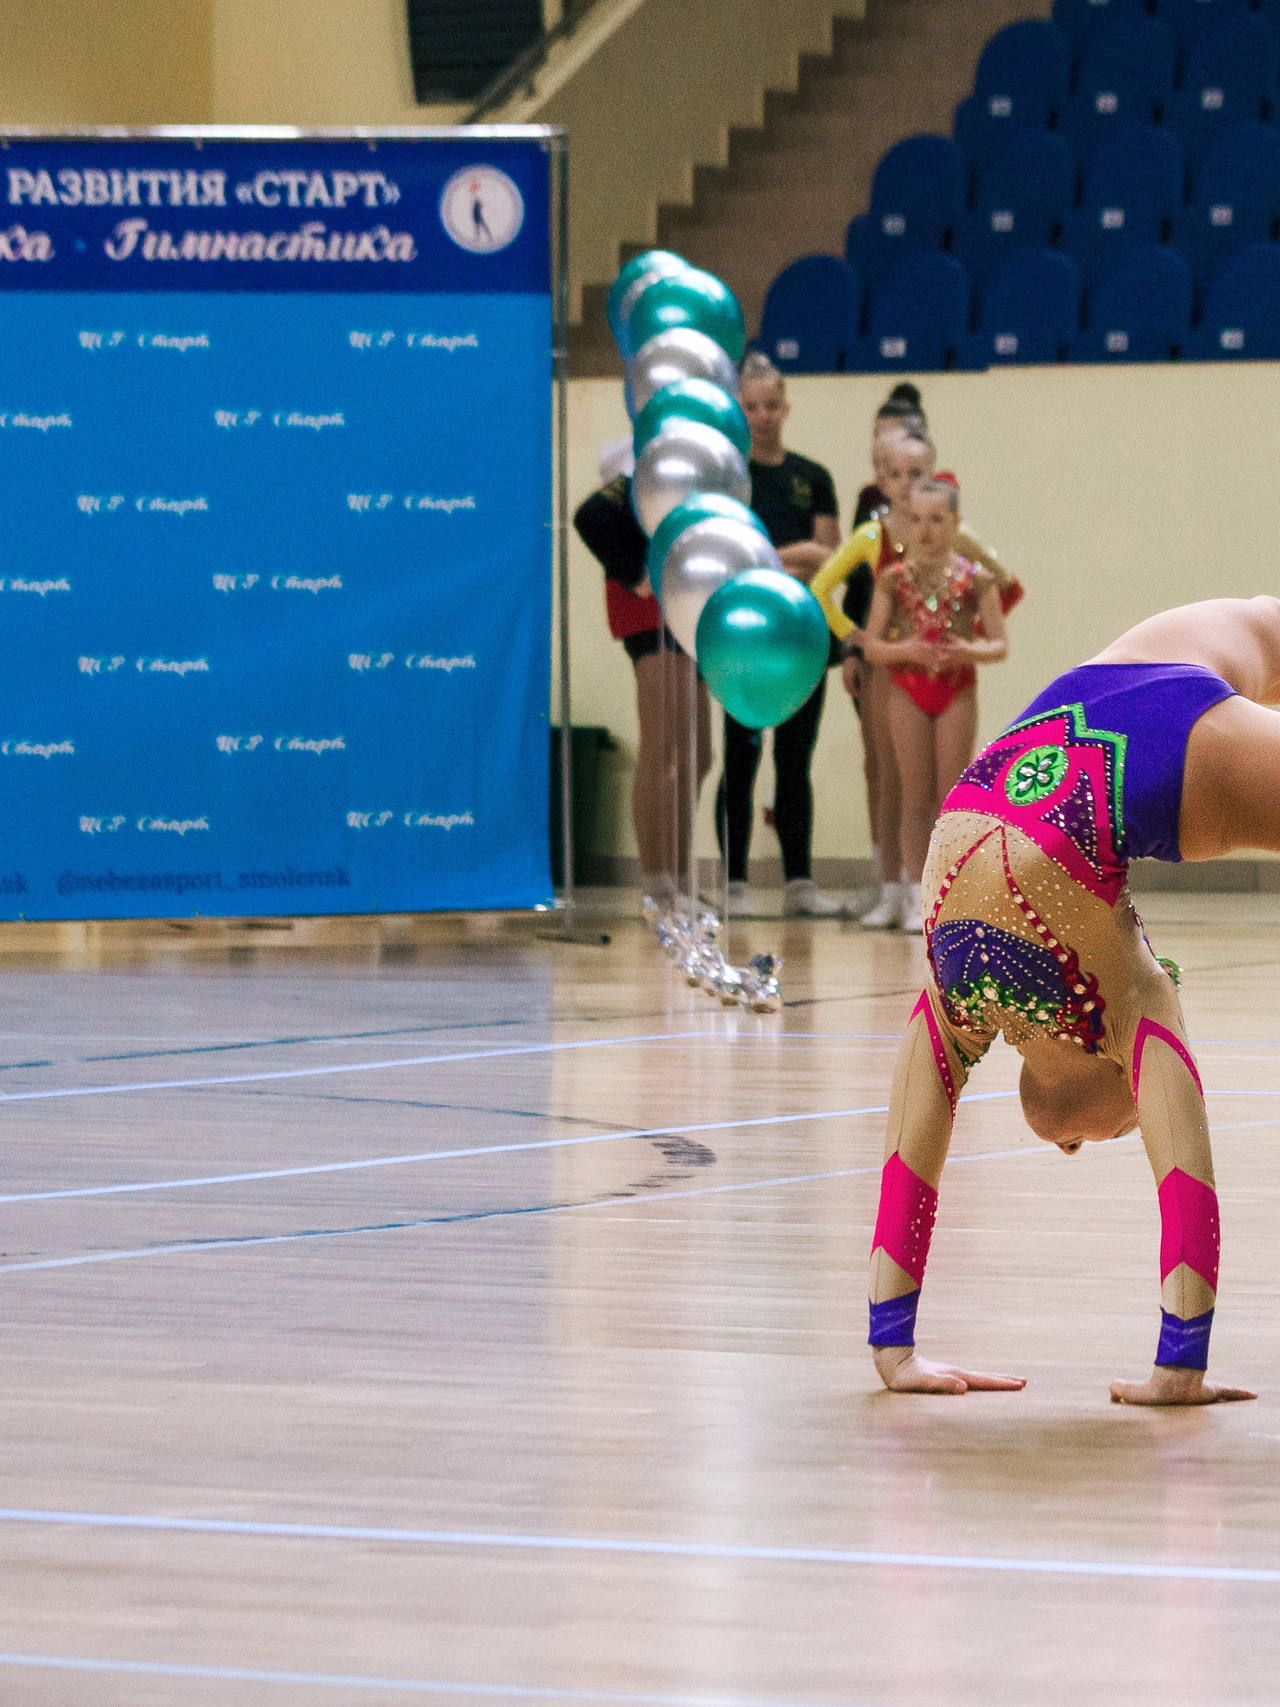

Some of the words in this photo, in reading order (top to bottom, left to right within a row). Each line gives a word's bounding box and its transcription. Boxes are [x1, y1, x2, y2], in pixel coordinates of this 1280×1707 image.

[7, 168, 227, 206] РАЗВИТИЯ
[235, 170, 402, 208] «СТАРТ»
[103, 217, 418, 263] Гимнастика
